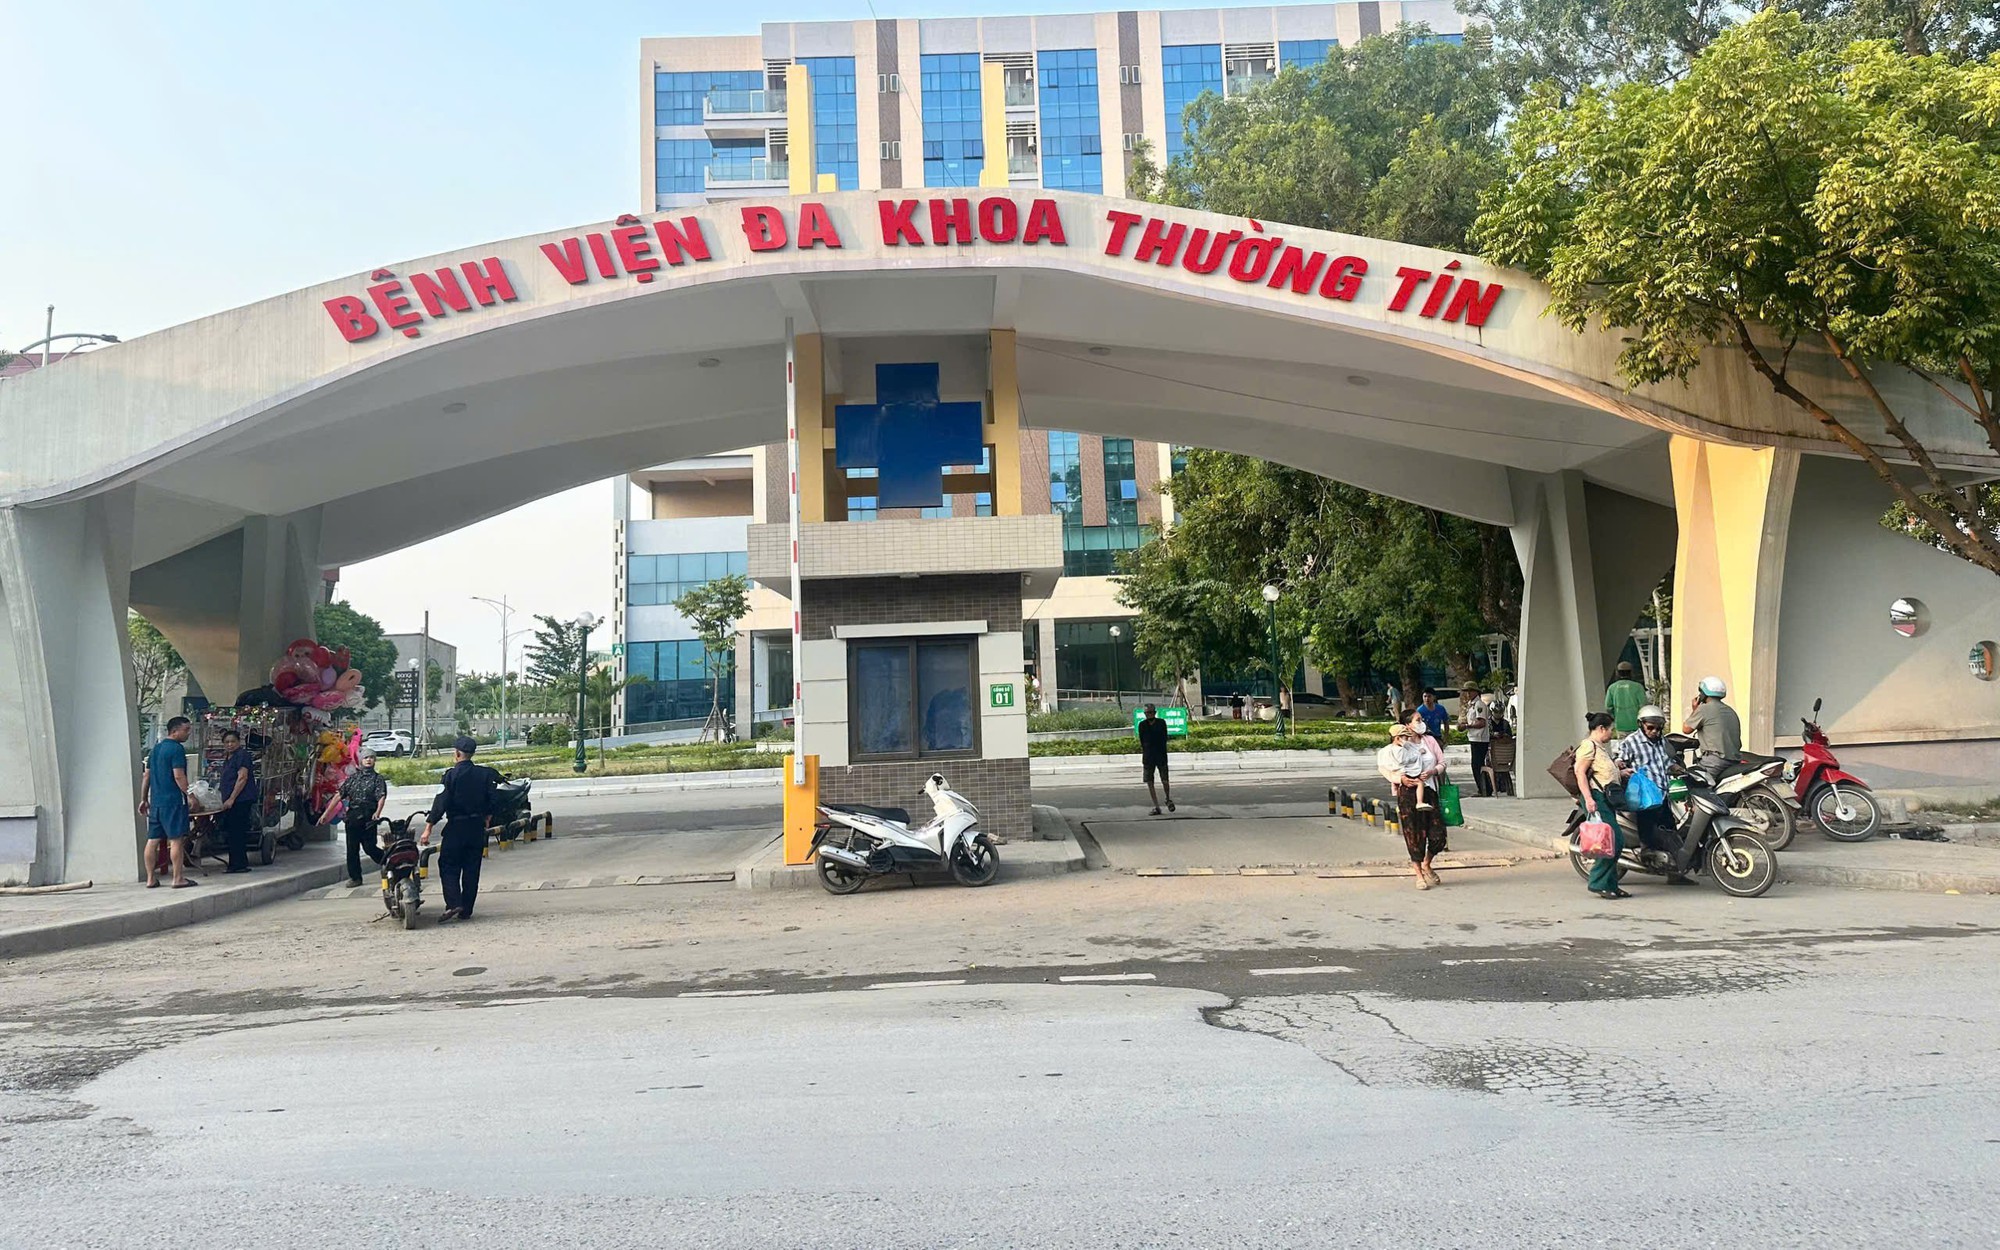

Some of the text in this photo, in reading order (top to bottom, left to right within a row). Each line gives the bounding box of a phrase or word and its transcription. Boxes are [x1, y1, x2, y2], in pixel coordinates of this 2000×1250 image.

[323, 197, 1504, 343] BỆNH VIỆN ĐA KHOA THƯỜNG TÍN
[996, 693, 1008, 704] 01
